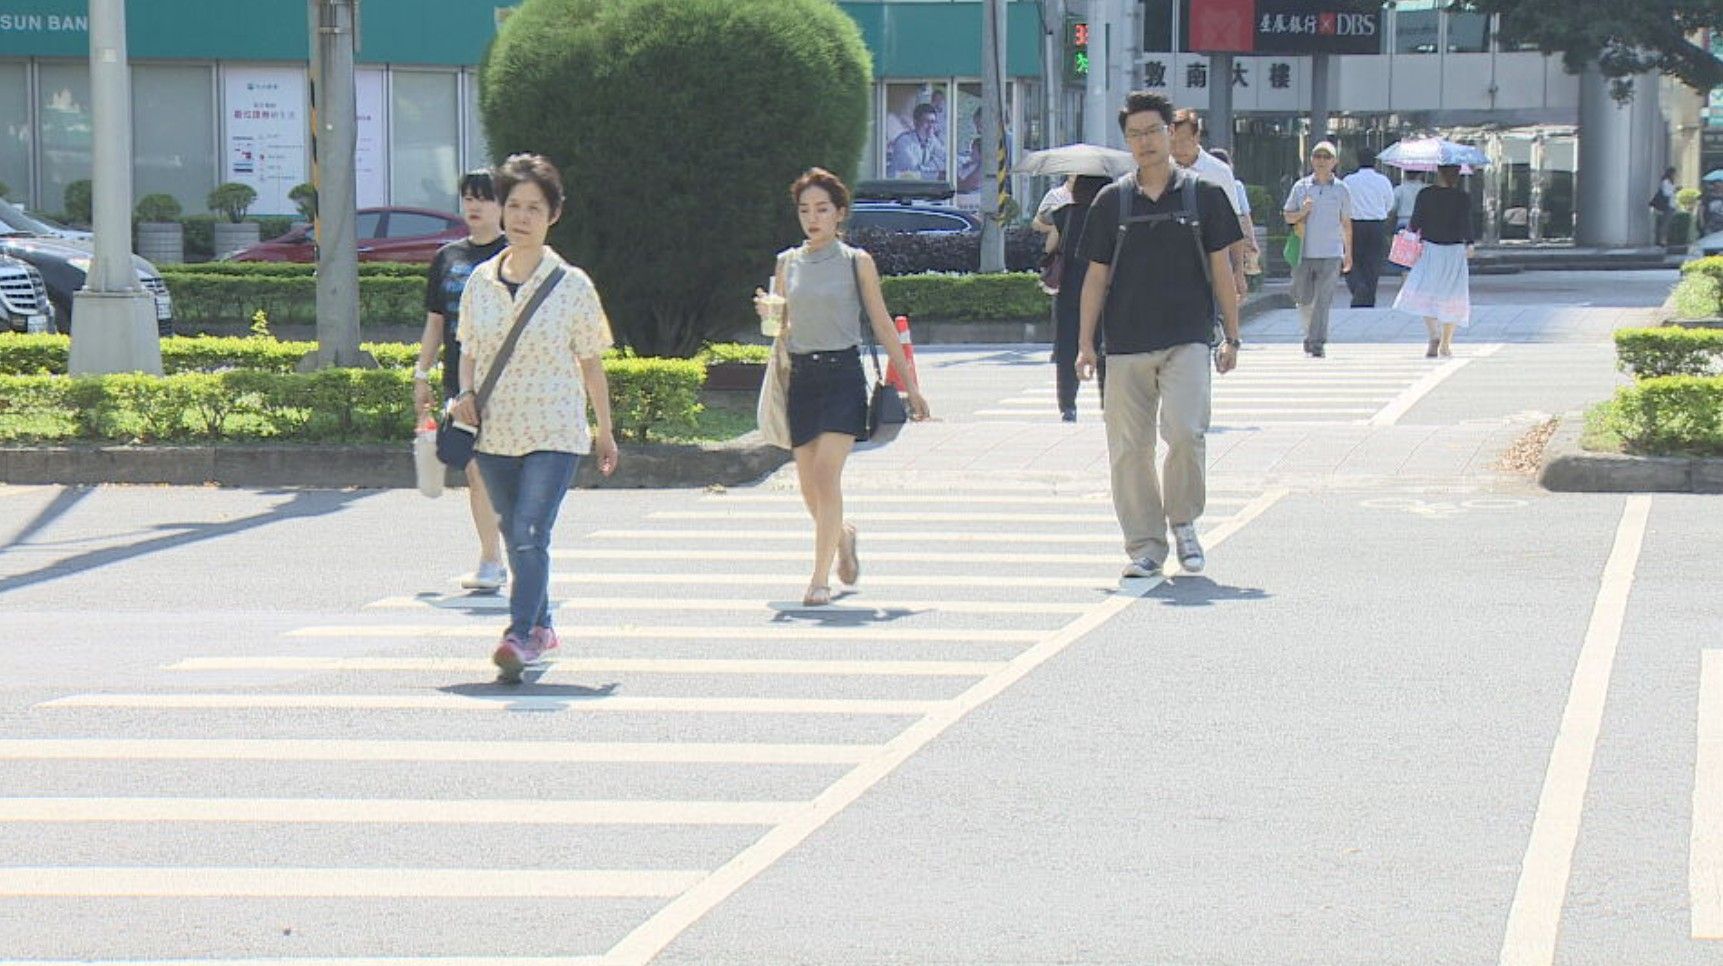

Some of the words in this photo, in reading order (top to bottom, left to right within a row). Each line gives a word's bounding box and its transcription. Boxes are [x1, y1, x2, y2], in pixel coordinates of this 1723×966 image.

[0, 15, 41, 30] SUN
[1336, 14, 1376, 36] DBS
[1144, 61, 1290, 89] 敦南大樓
